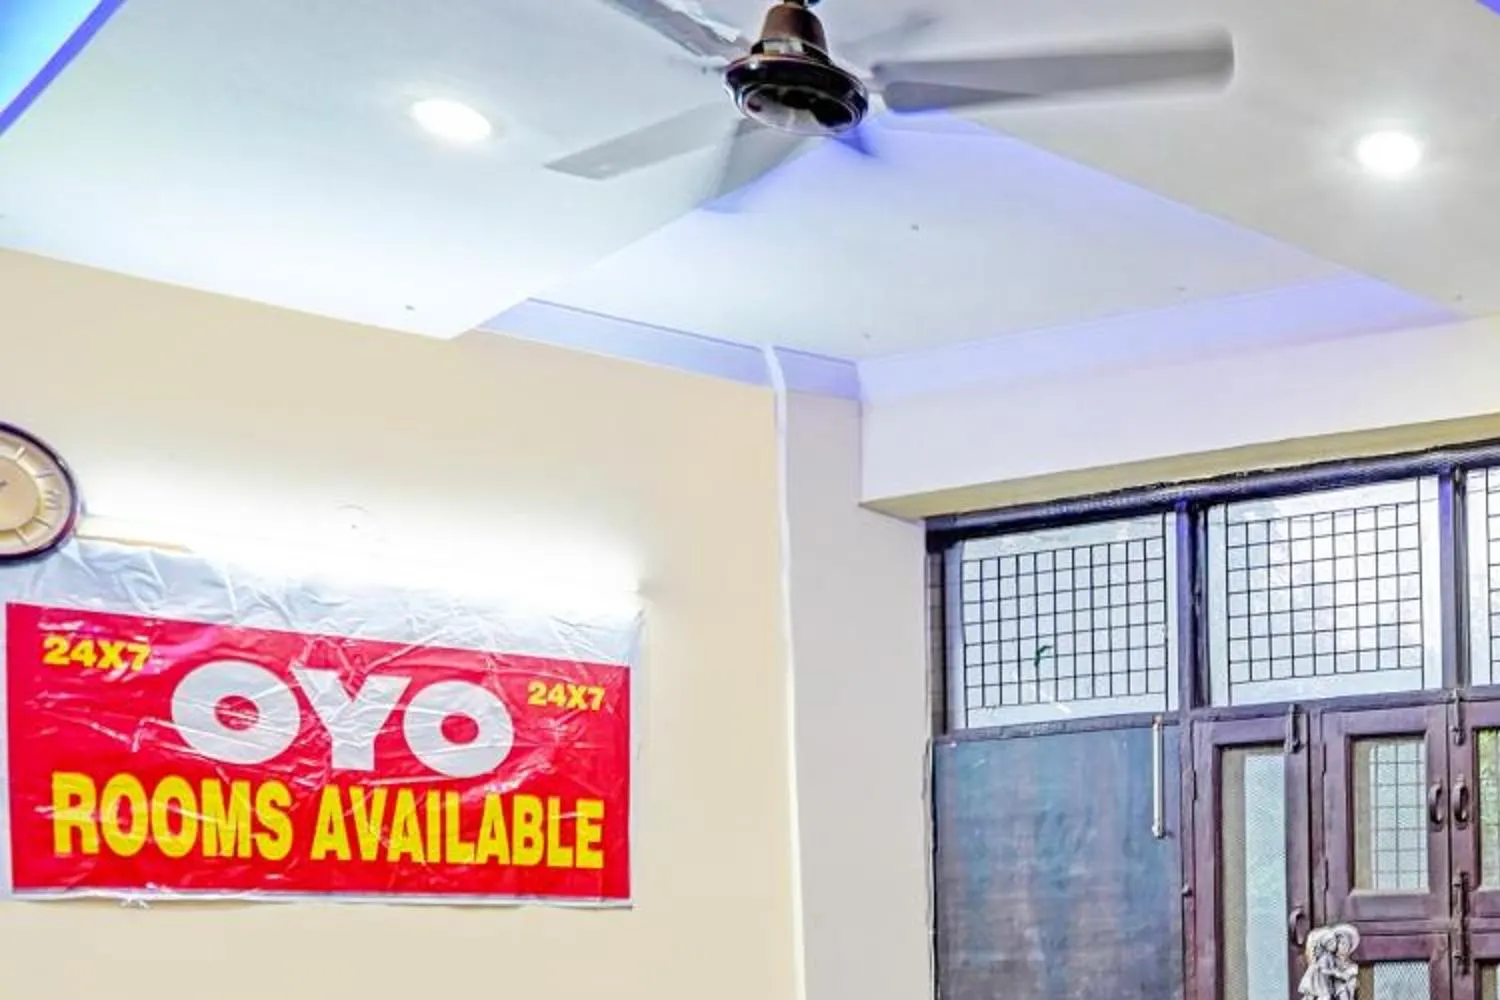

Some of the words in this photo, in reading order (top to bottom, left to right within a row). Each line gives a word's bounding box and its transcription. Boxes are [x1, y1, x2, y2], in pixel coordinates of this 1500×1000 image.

[42, 636, 150, 671] 24X7
[171, 660, 514, 778] OYO
[527, 681, 606, 711] 24X7
[51, 772, 294, 860] ROOMS
[310, 784, 605, 869] AVAILABLE
